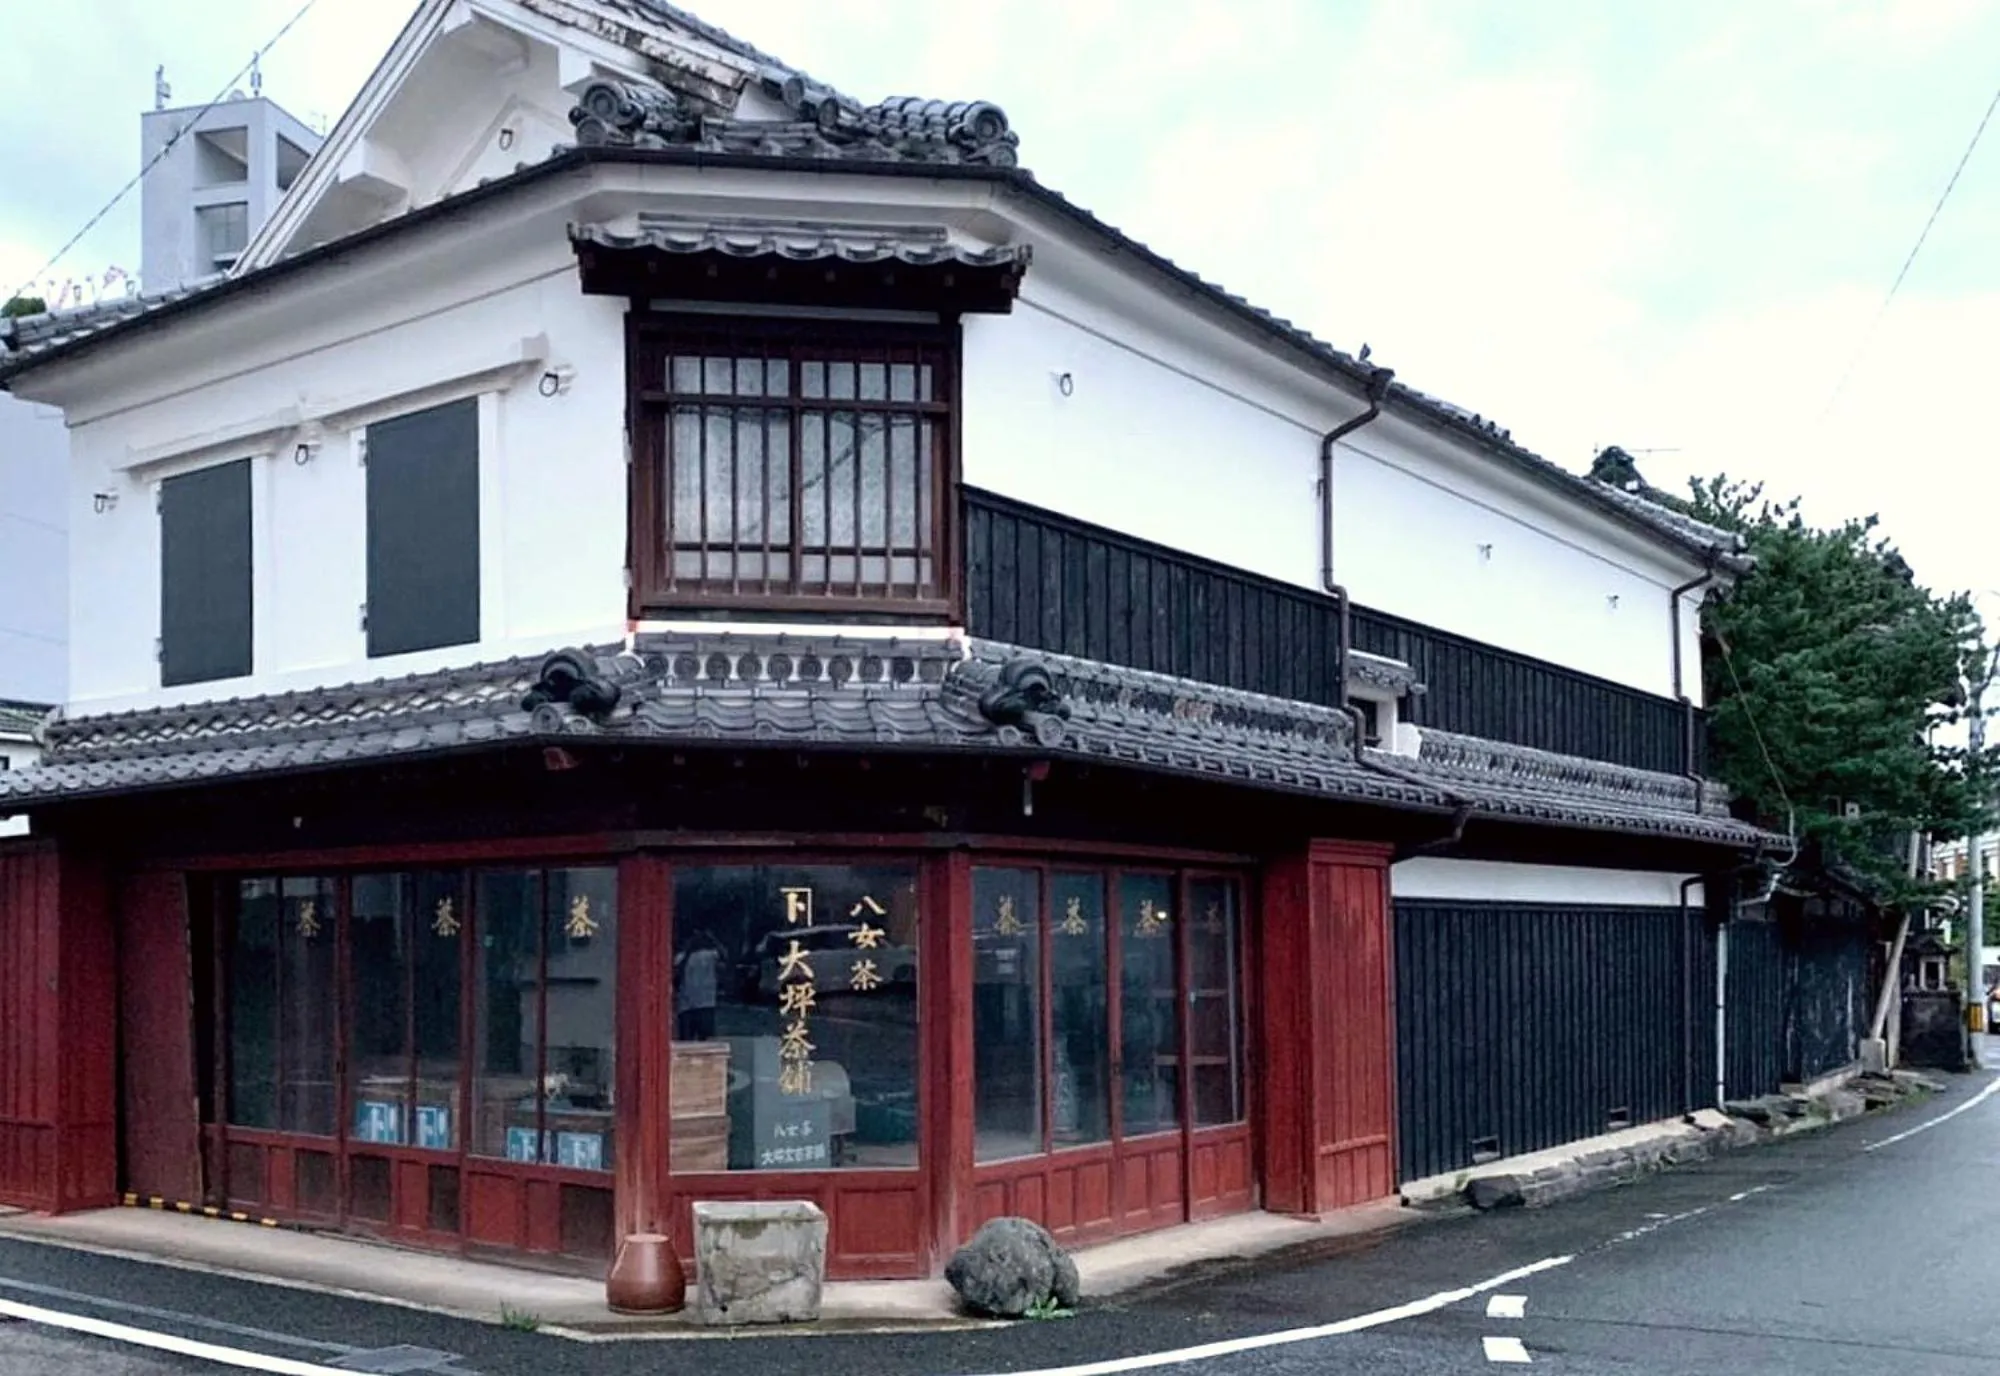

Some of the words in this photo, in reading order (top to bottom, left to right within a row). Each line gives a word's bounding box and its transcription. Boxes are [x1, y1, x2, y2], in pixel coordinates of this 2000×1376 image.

[431, 894, 461, 937] 茶
[564, 893, 600, 939] 茶
[848, 895, 888, 990] 八女茶
